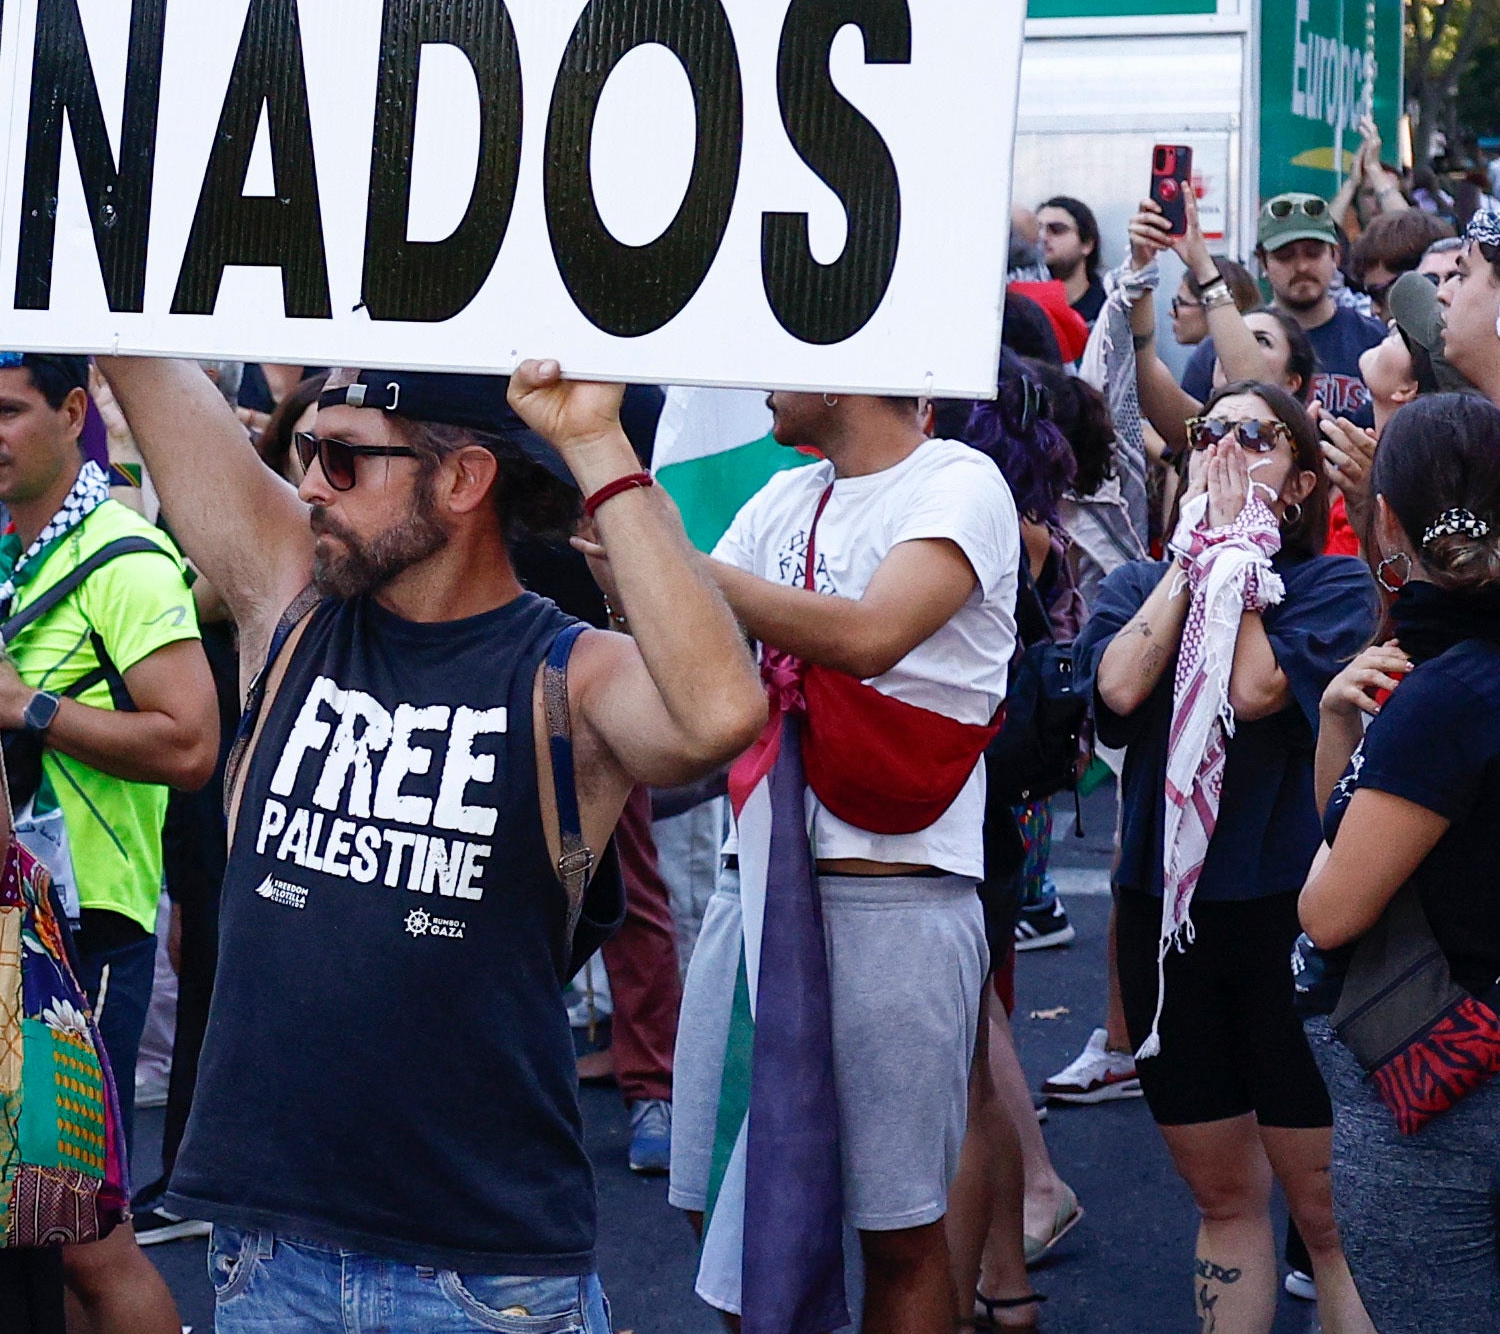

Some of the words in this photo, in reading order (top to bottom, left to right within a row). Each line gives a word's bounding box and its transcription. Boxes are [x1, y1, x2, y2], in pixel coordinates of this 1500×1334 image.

[269, 675, 507, 835] FREE
[255, 798, 491, 901] PALESTINE
[274, 879, 308, 896] FREEDOM
[430, 924, 464, 939] GAZA
